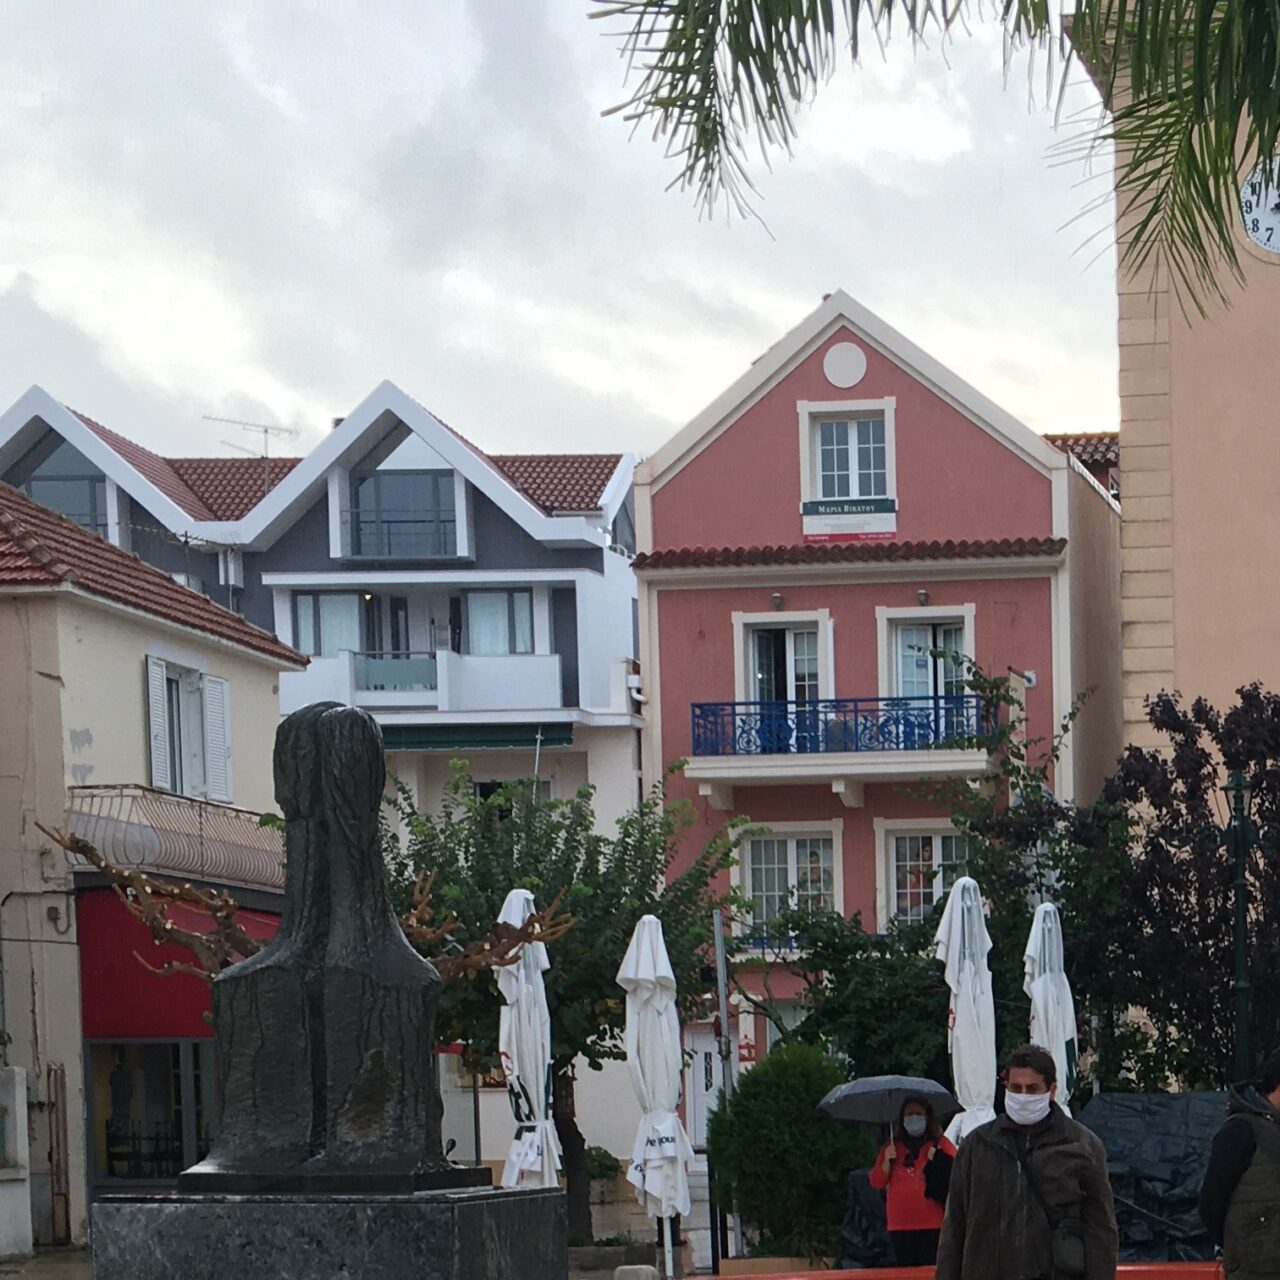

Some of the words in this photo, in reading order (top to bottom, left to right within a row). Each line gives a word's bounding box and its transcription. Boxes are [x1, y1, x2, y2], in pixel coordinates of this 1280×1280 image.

[1249, 181, 1261, 197] 10
[1244, 199, 1253, 215] 9
[1251, 217, 1260, 233] 8
[1265, 227, 1274, 242] 7
